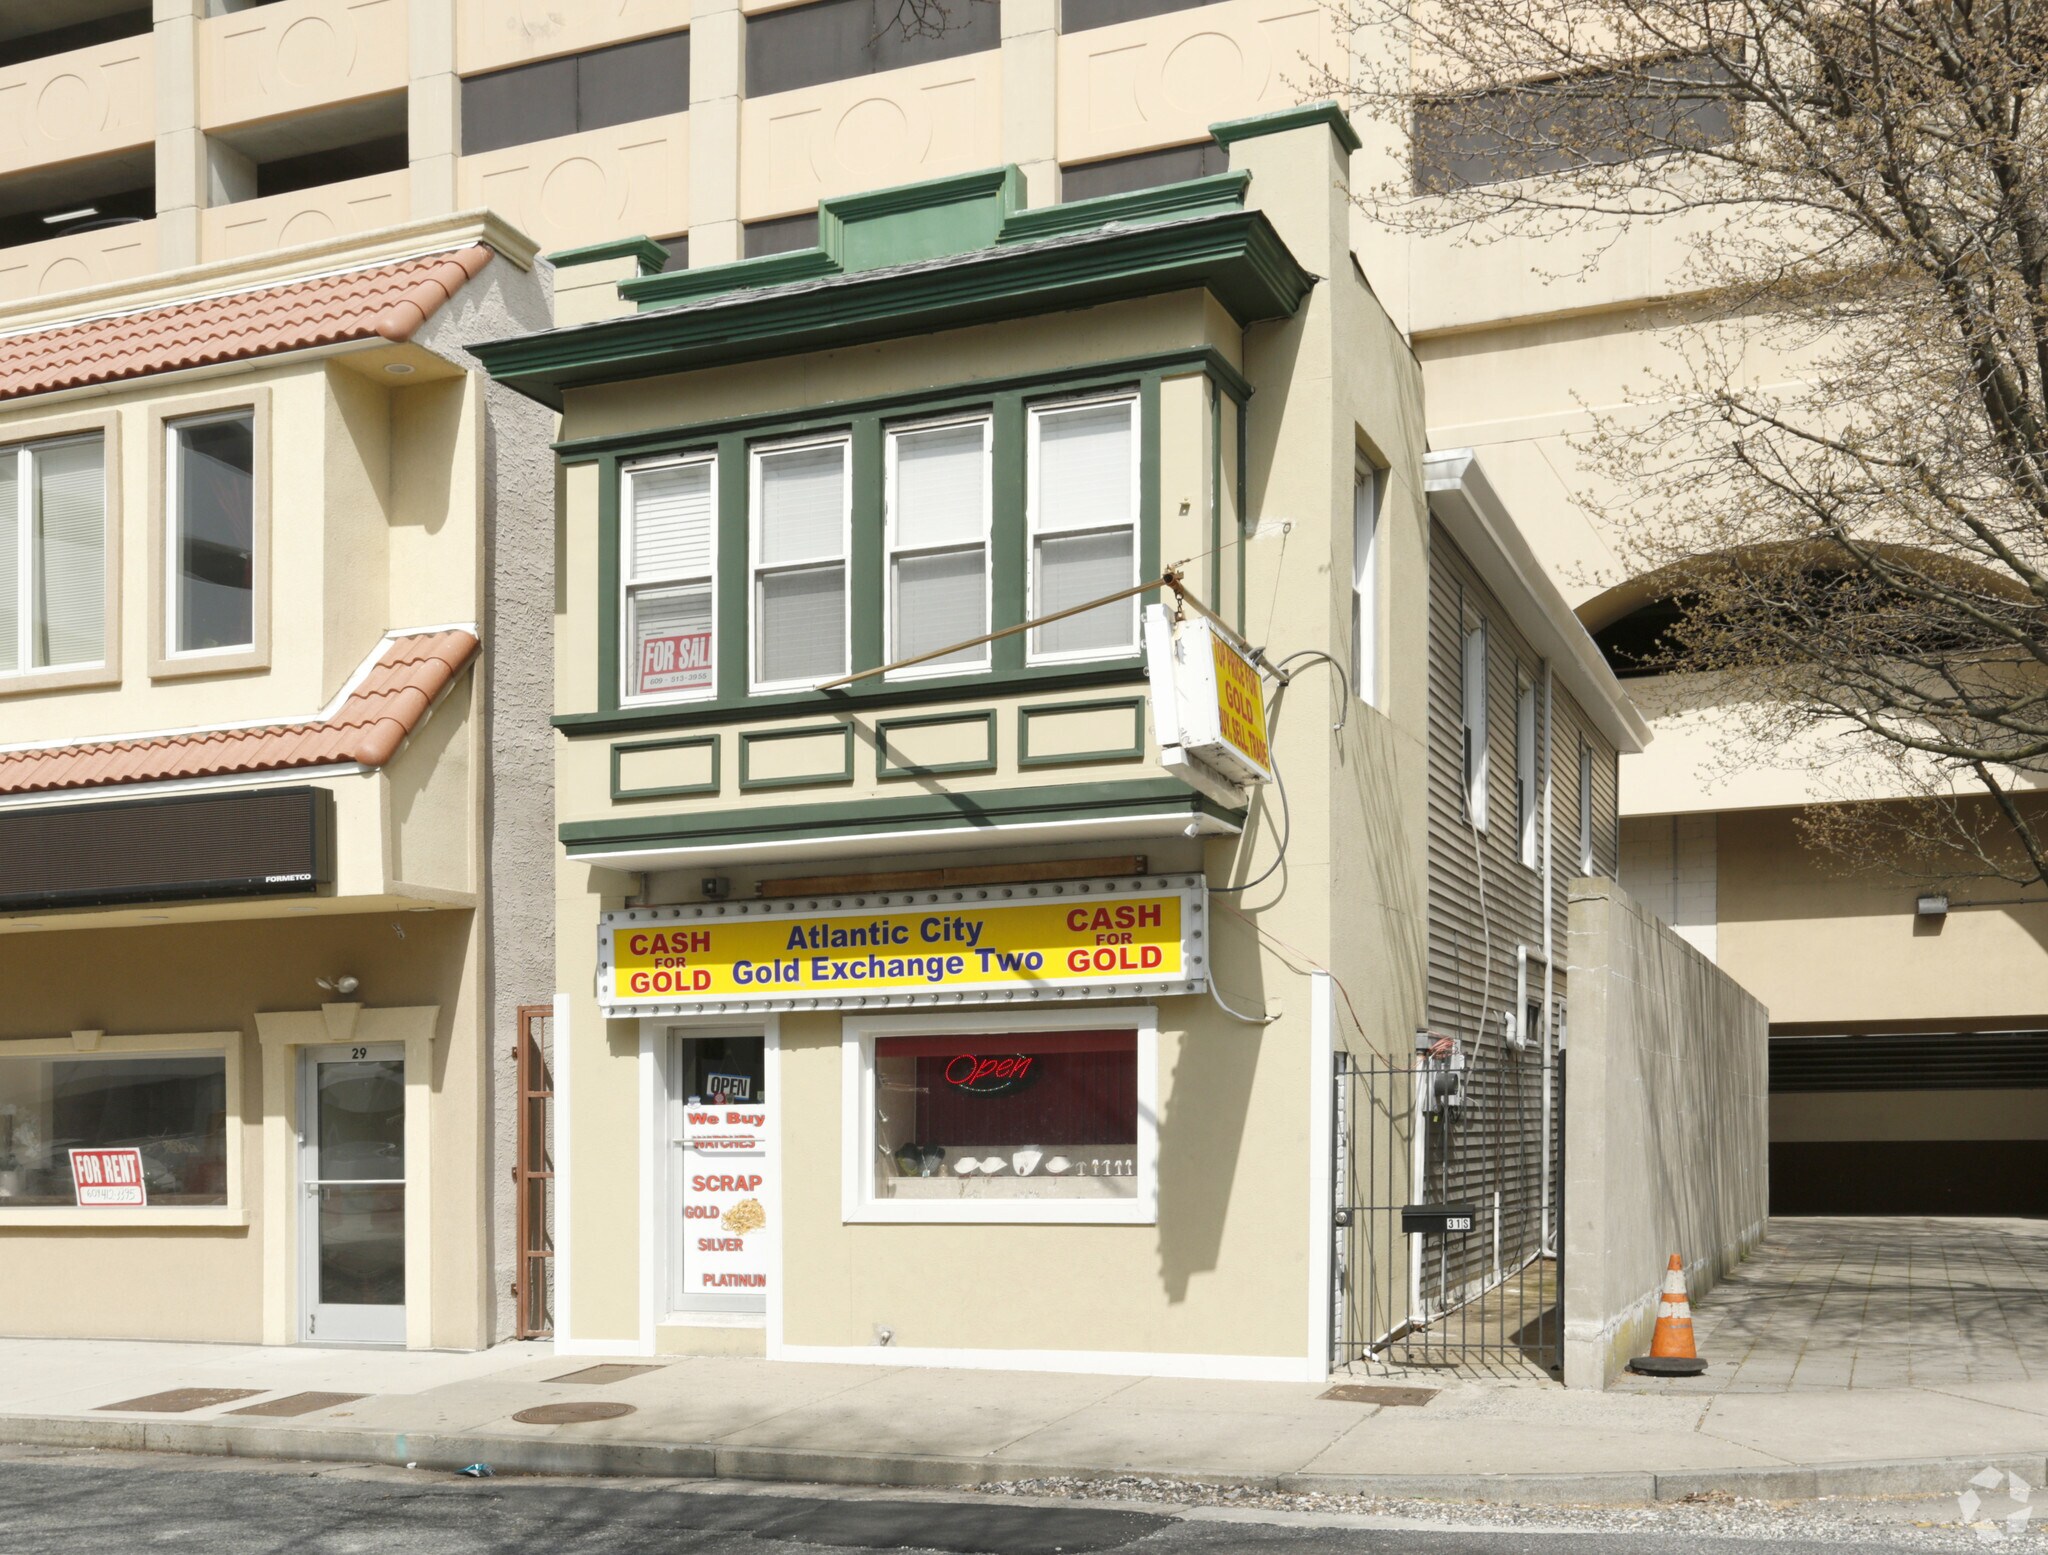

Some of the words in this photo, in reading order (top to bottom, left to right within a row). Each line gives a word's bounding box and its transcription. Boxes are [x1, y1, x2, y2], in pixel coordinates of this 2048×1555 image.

[644, 640, 676, 673] FOR
[1225, 680, 1254, 725] GOLD
[265, 873, 312, 883] FORMETCO
[1066, 904, 1161, 932] CASH
[629, 931, 711, 956] CASH
[786, 920, 909, 951] Atlantic
[920, 916, 984, 947] City
[1095, 932, 1133, 946] FOR
[654, 957, 686, 969] FOR
[732, 958, 800, 985] Gold
[811, 953, 965, 983] Exchange
[974, 947, 1044, 973] Two
[1067, 945, 1162, 973] GOLD
[630, 969, 712, 994] GOLD
[352, 1047, 367, 1060] 29
[945, 1053, 1033, 1085] Open
[710, 1076, 748, 1097] OPEN
[687, 1112, 720, 1125] We
[726, 1112, 766, 1127] Buy
[75, 1154, 103, 1184] FOR
[102, 1153, 137, 1184] RENT
[691, 1175, 763, 1192] SCRAP
[684, 1205, 720, 1219] GOLD
[697, 1238, 744, 1252] SILVER
